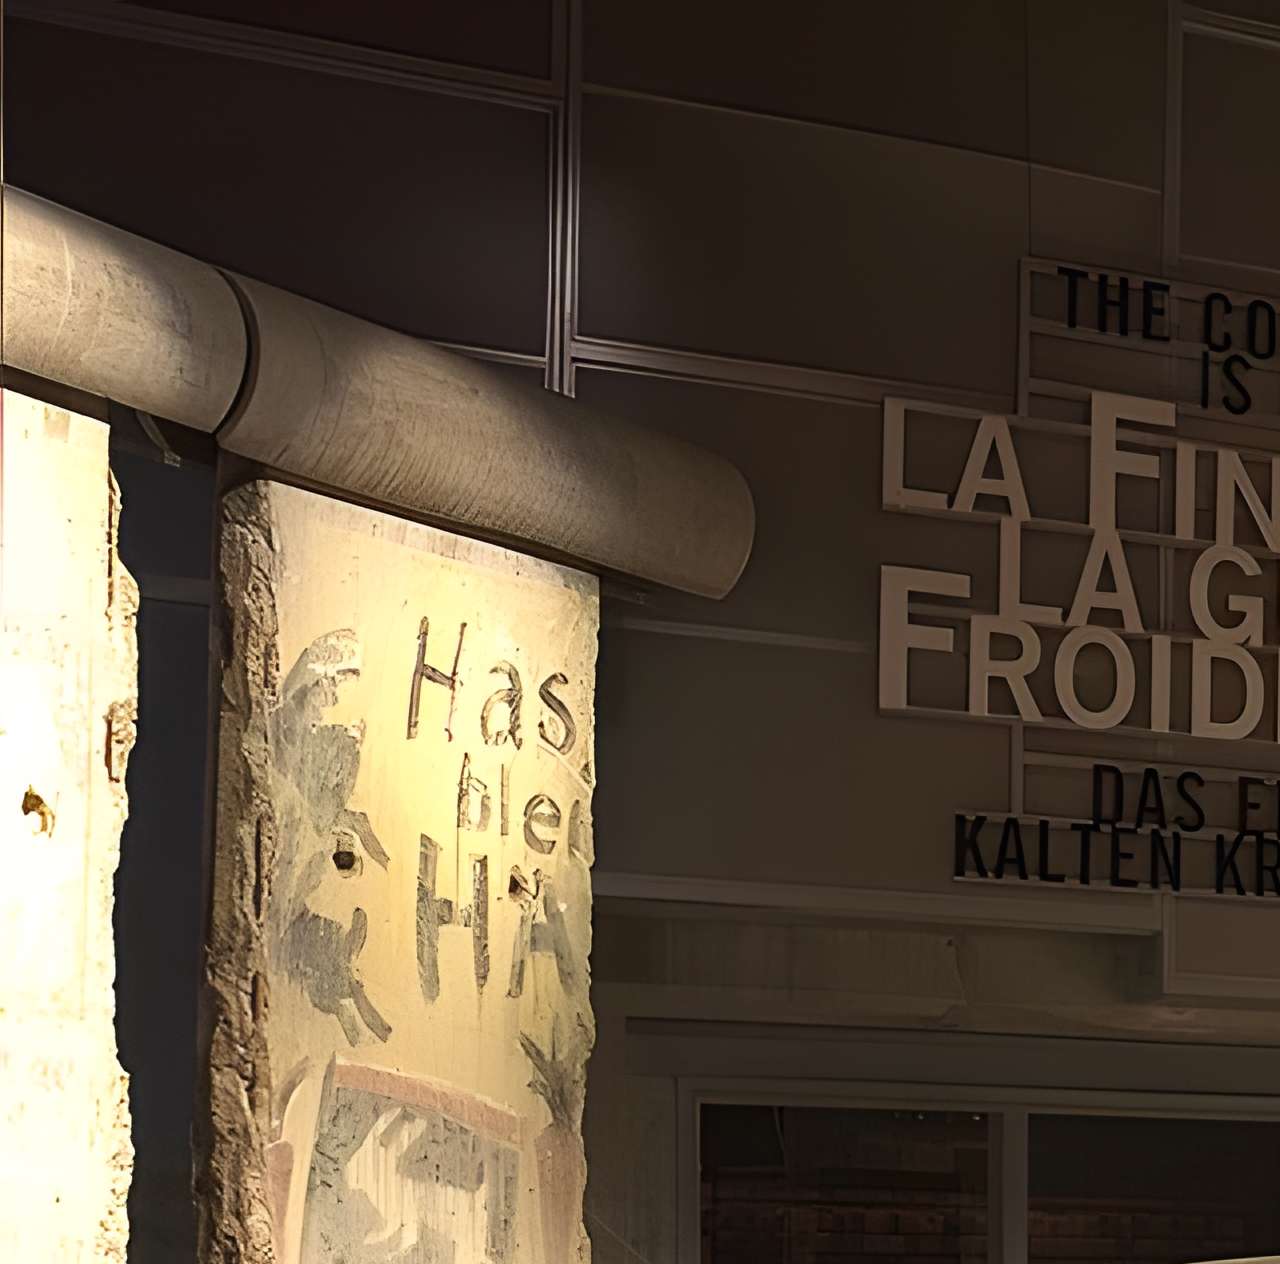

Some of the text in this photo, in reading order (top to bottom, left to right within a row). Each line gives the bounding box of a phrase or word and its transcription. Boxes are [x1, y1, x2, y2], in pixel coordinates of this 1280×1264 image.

[1056, 266, 1171, 342] THE
[1200, 350, 1253, 415] IS
[882, 397, 1031, 521] LA
[999, 517, 1145, 633] LA
[406, 616, 577, 756] Has
[1091, 763, 1206, 834] DAS
[954, 813, 1182, 893] KALTEN
